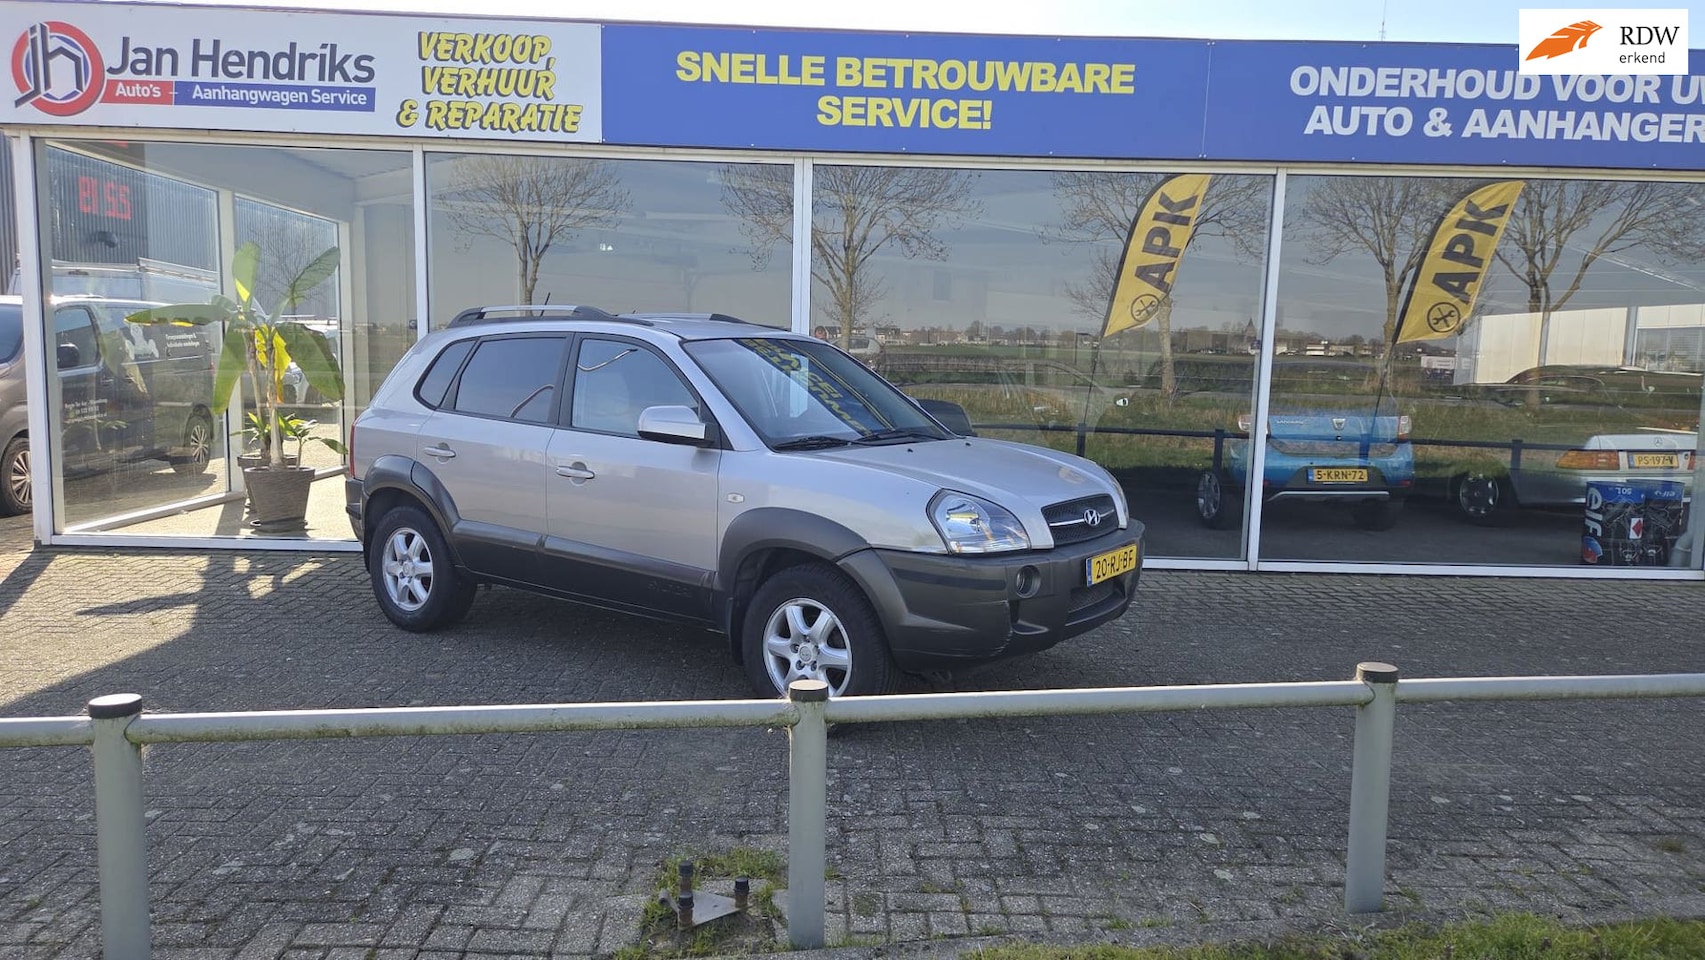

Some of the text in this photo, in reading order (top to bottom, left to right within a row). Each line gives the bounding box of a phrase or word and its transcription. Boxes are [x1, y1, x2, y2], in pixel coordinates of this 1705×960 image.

[106, 36, 376, 84] Jan Hendriks
[418, 31, 556, 69] VERKOOP,
[422, 65, 556, 101] VERHUUR
[676, 51, 1136, 94] SNELLE BETROUWBARE
[1290, 65, 1541, 101] ONDERHOUD
[1552, 74, 1661, 104] VOOR
[115, 81, 162, 98] Auto's
[192, 84, 309, 106] Aanhangwagen
[311, 89, 368, 105] Service
[816, 95, 992, 130] SERVICE!
[396, 99, 584, 134] & REPARATIE
[1303, 104, 1705, 144] AUTO & AANHANGER
[1134, 191, 1199, 294] APK
[1432, 199, 1510, 306] APK
[1316, 470, 1365, 480] 5-KRN-72
[1095, 549, 1134, 579] 20-RJ-BF
